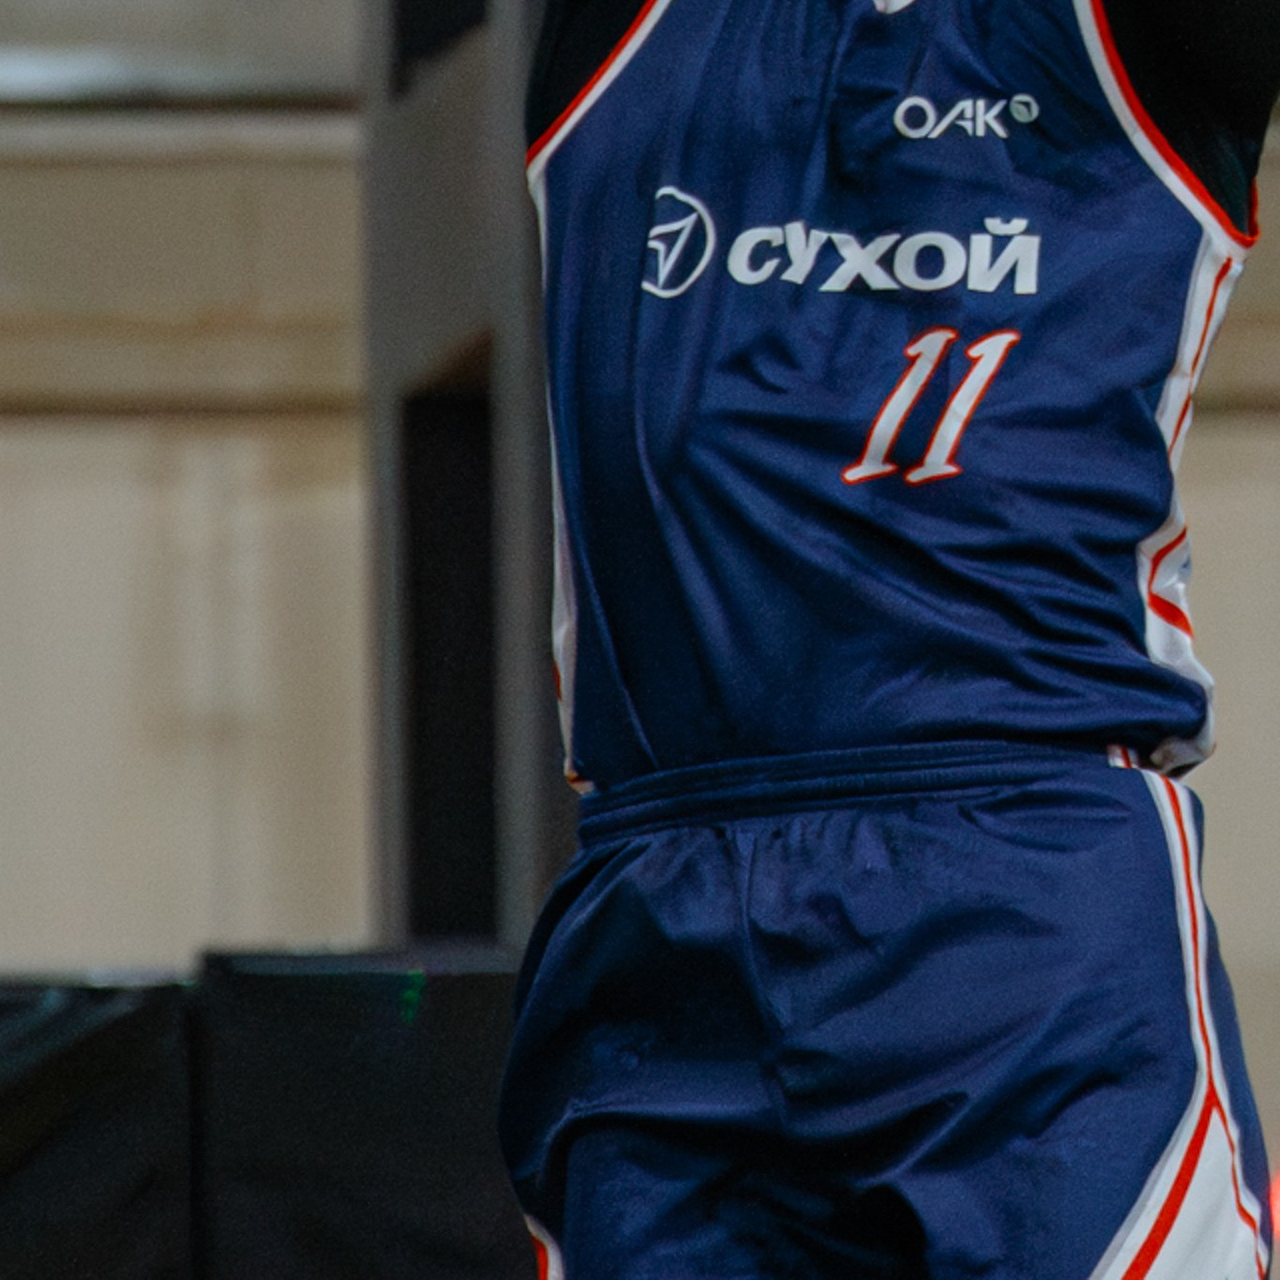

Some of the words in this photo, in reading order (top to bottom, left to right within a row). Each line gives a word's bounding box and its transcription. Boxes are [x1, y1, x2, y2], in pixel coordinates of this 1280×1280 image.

[893, 95, 1009, 139] ОАК
[726, 217, 1041, 295] СУХОЙ
[841, 326, 1021, 485] 11
